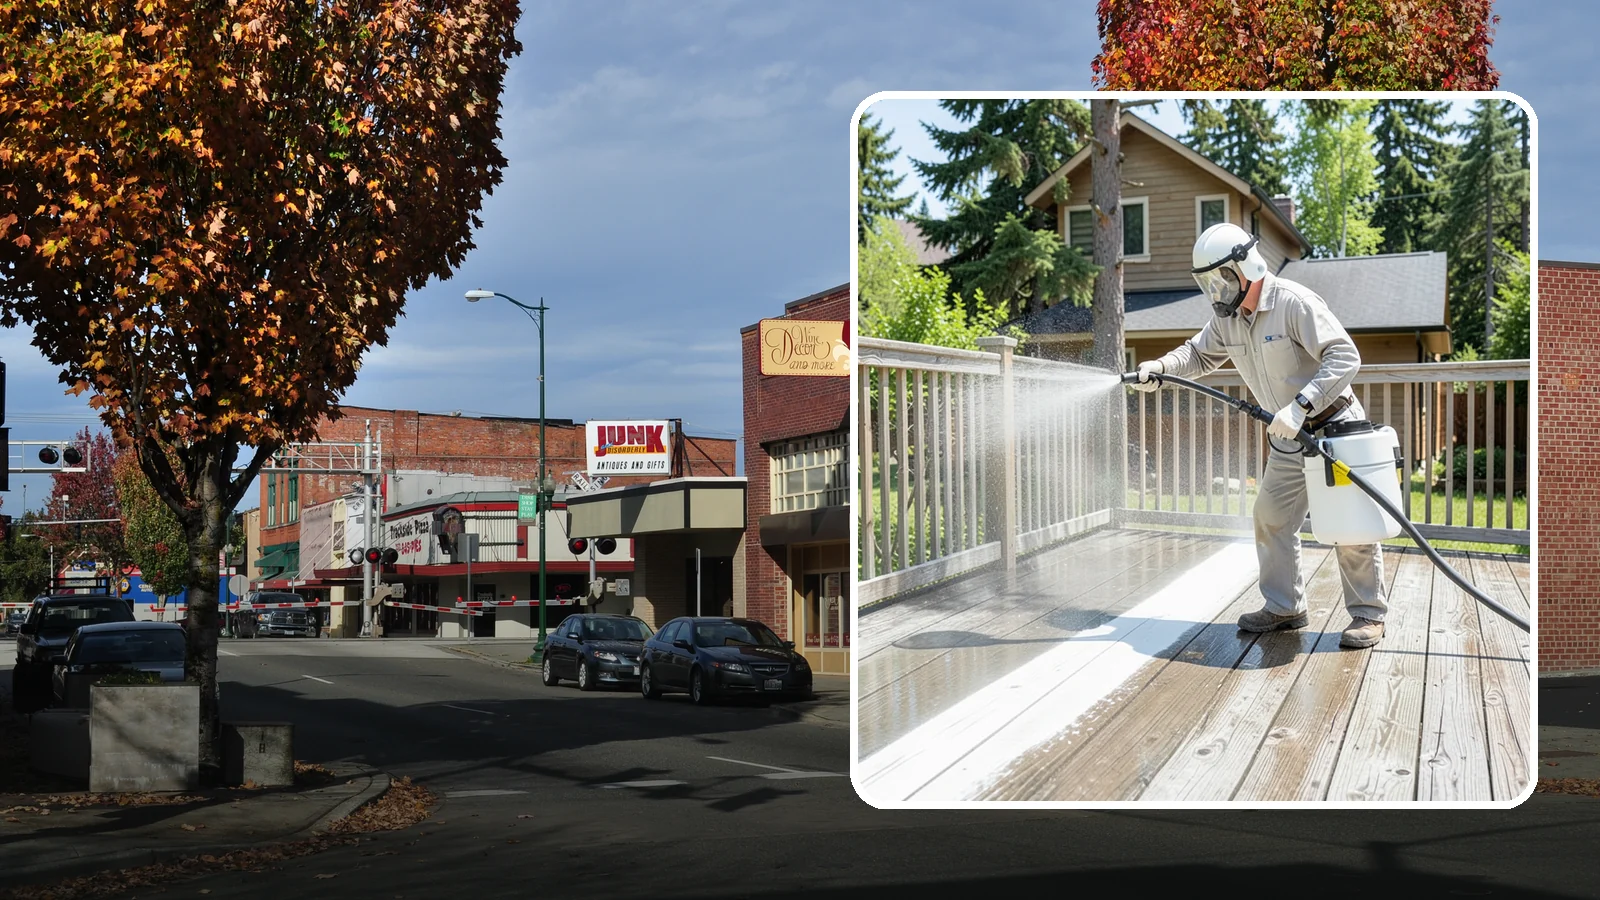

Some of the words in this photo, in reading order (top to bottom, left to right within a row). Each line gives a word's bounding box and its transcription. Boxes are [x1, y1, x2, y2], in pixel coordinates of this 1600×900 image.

[595, 425, 664, 457] JUNK
[607, 446, 646, 454] DISORDERLY
[597, 461, 628, 470] ANTIQUES
[631, 461, 644, 470] AND
[647, 460, 665, 470] GIFTS
[590, 475, 608, 491] SING
[390, 521, 413, 540] Trackside
[415, 519, 429, 535] Pizza
